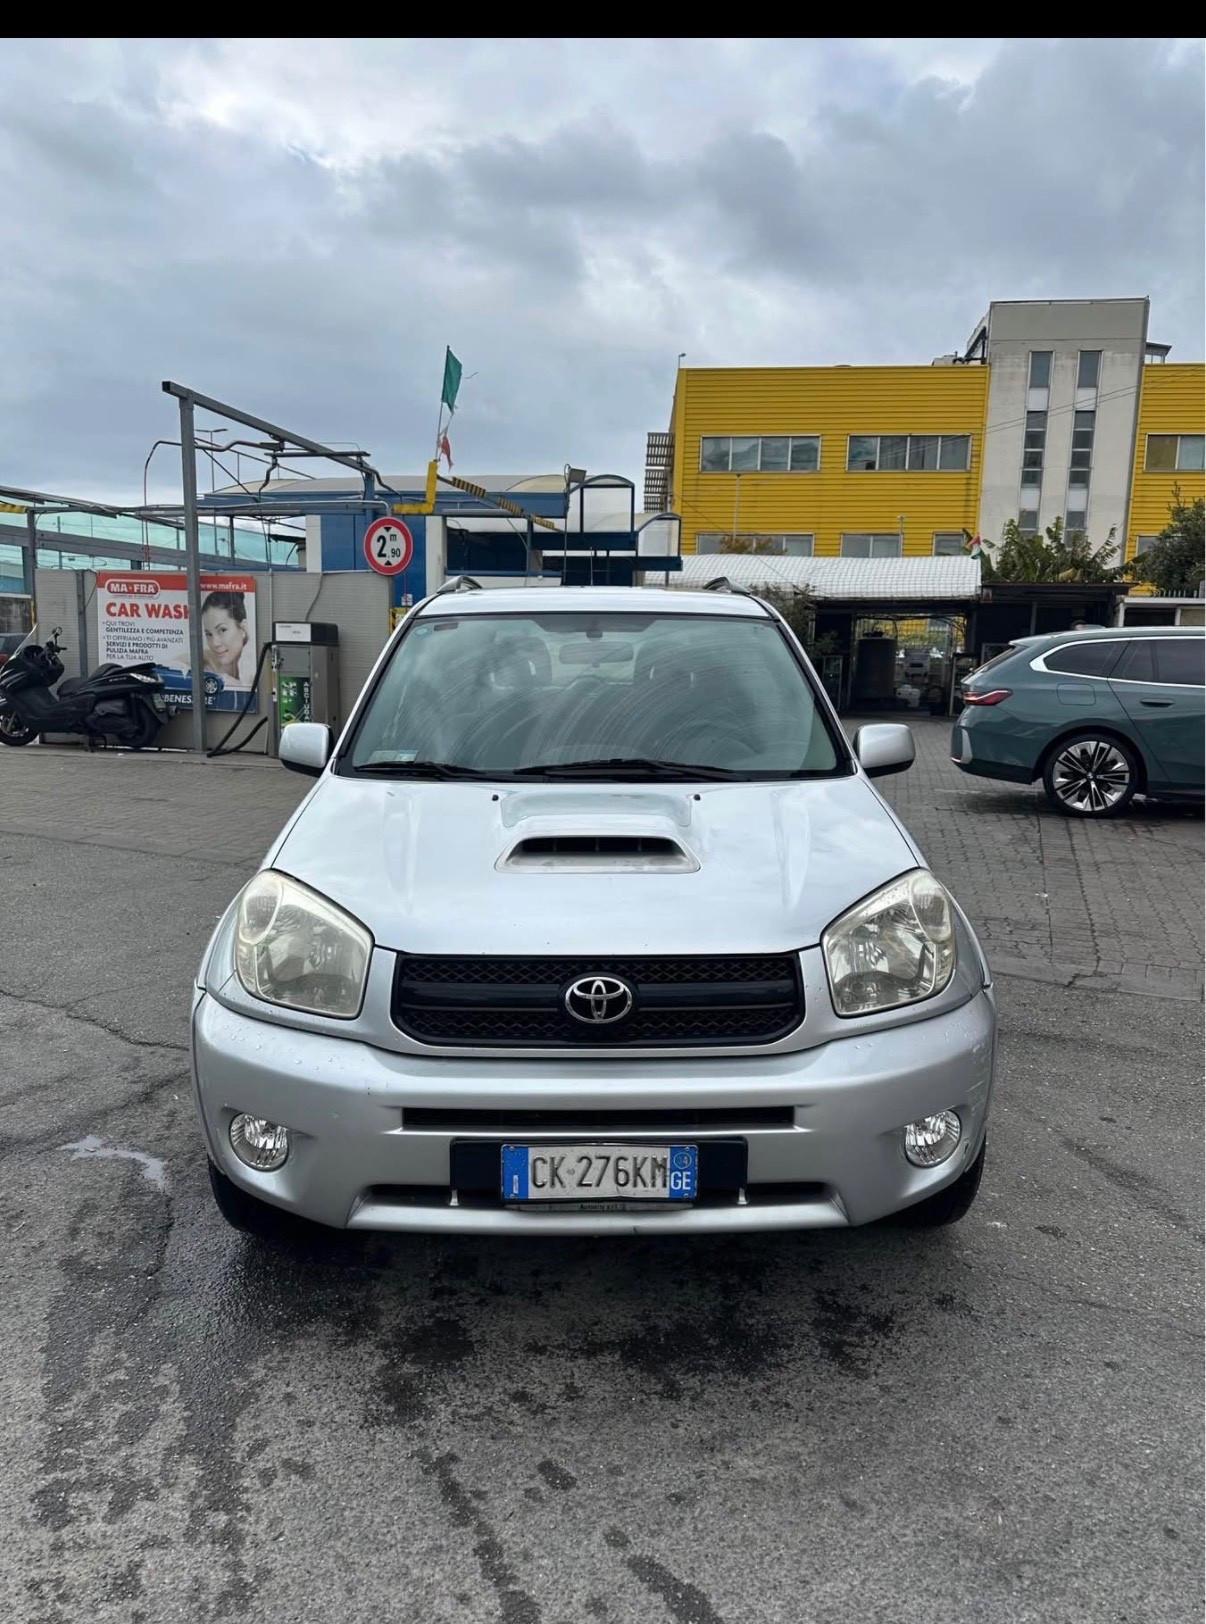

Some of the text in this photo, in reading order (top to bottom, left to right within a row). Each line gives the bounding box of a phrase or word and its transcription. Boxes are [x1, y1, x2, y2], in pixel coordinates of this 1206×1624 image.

[376, 534, 387, 558] 2
[389, 534, 397, 542] m
[106, 601, 141, 618] CAR
[532, 1155, 566, 1188] CK
[575, 1155, 668, 1189] 276KM
[670, 1171, 692, 1190] GE
